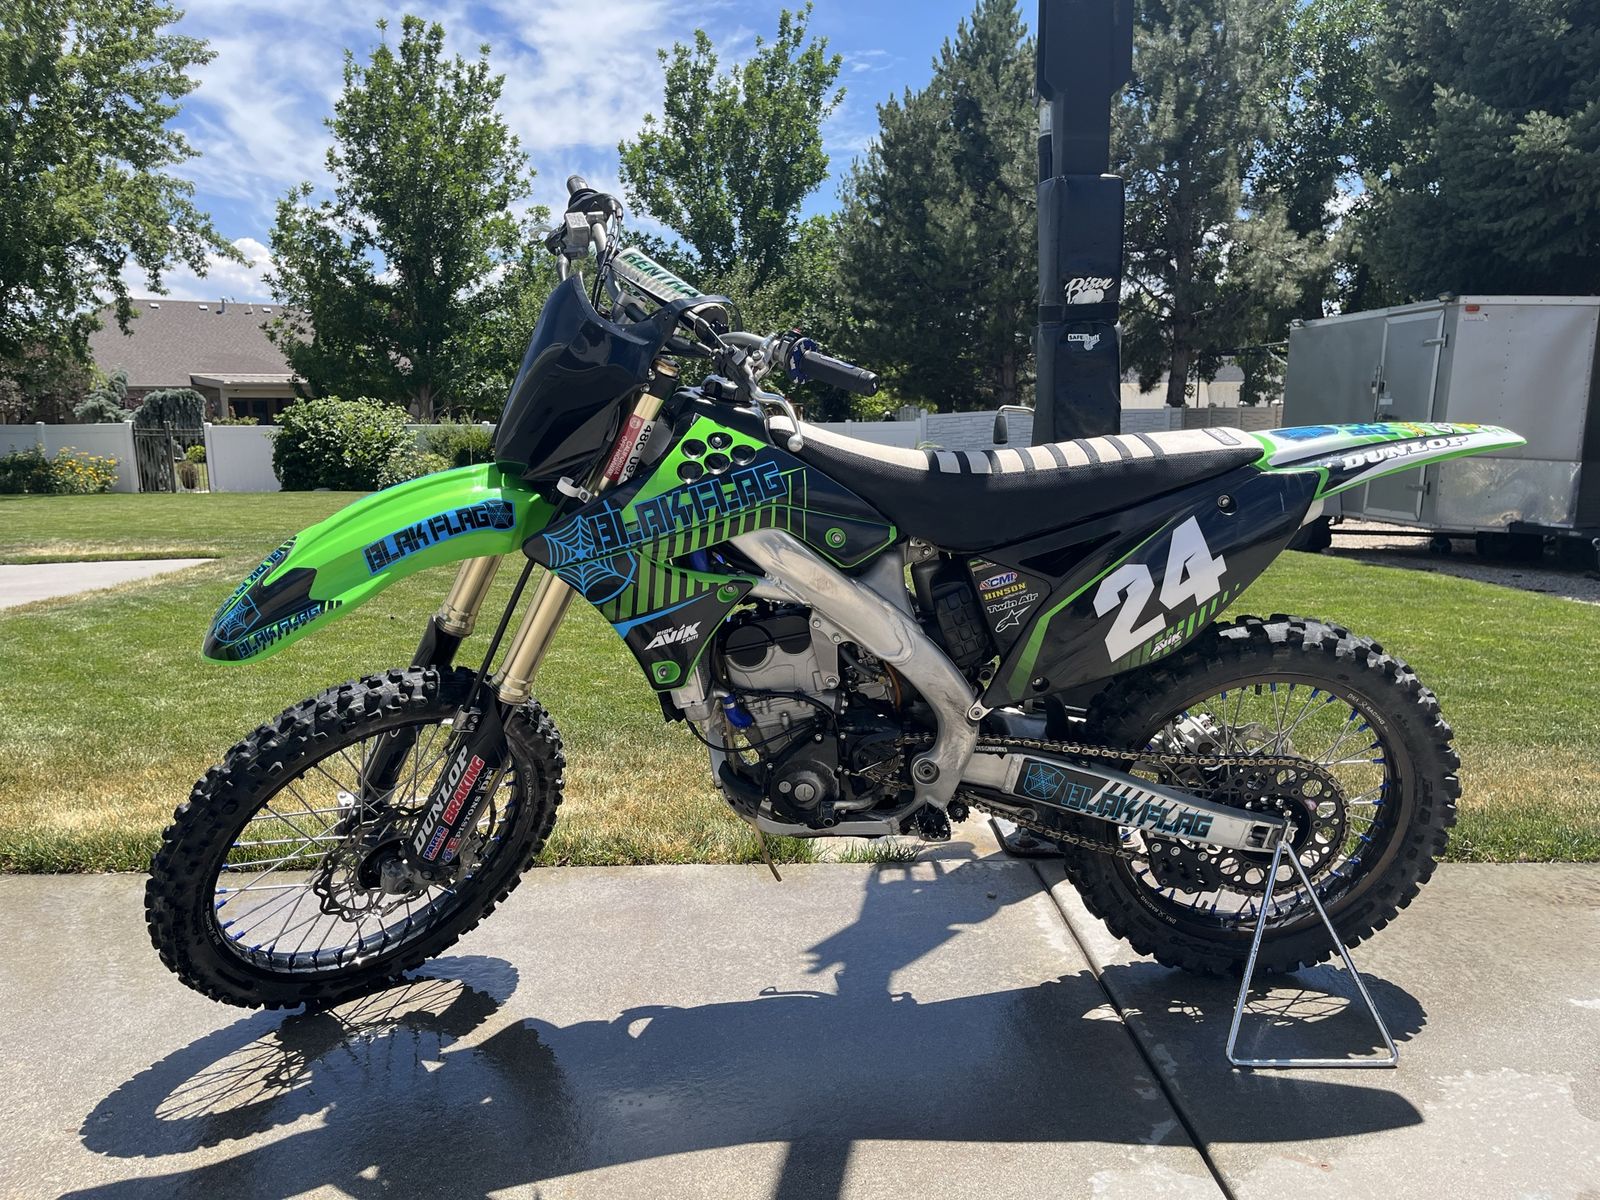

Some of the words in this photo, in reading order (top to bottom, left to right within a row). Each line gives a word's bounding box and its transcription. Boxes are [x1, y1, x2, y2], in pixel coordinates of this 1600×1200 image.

[635, 424, 652, 451] 48C
[1341, 435, 1469, 471] DUNLOP
[363, 522, 431, 573] BLAK
[427, 503, 493, 542] FLAG
[984, 582, 1027, 601] HINSON
[1092, 515, 1228, 663] 24
[413, 744, 468, 856] DUNLOP
[442, 754, 486, 826] BRAKING
[456, 795, 482, 838] PISTONS
